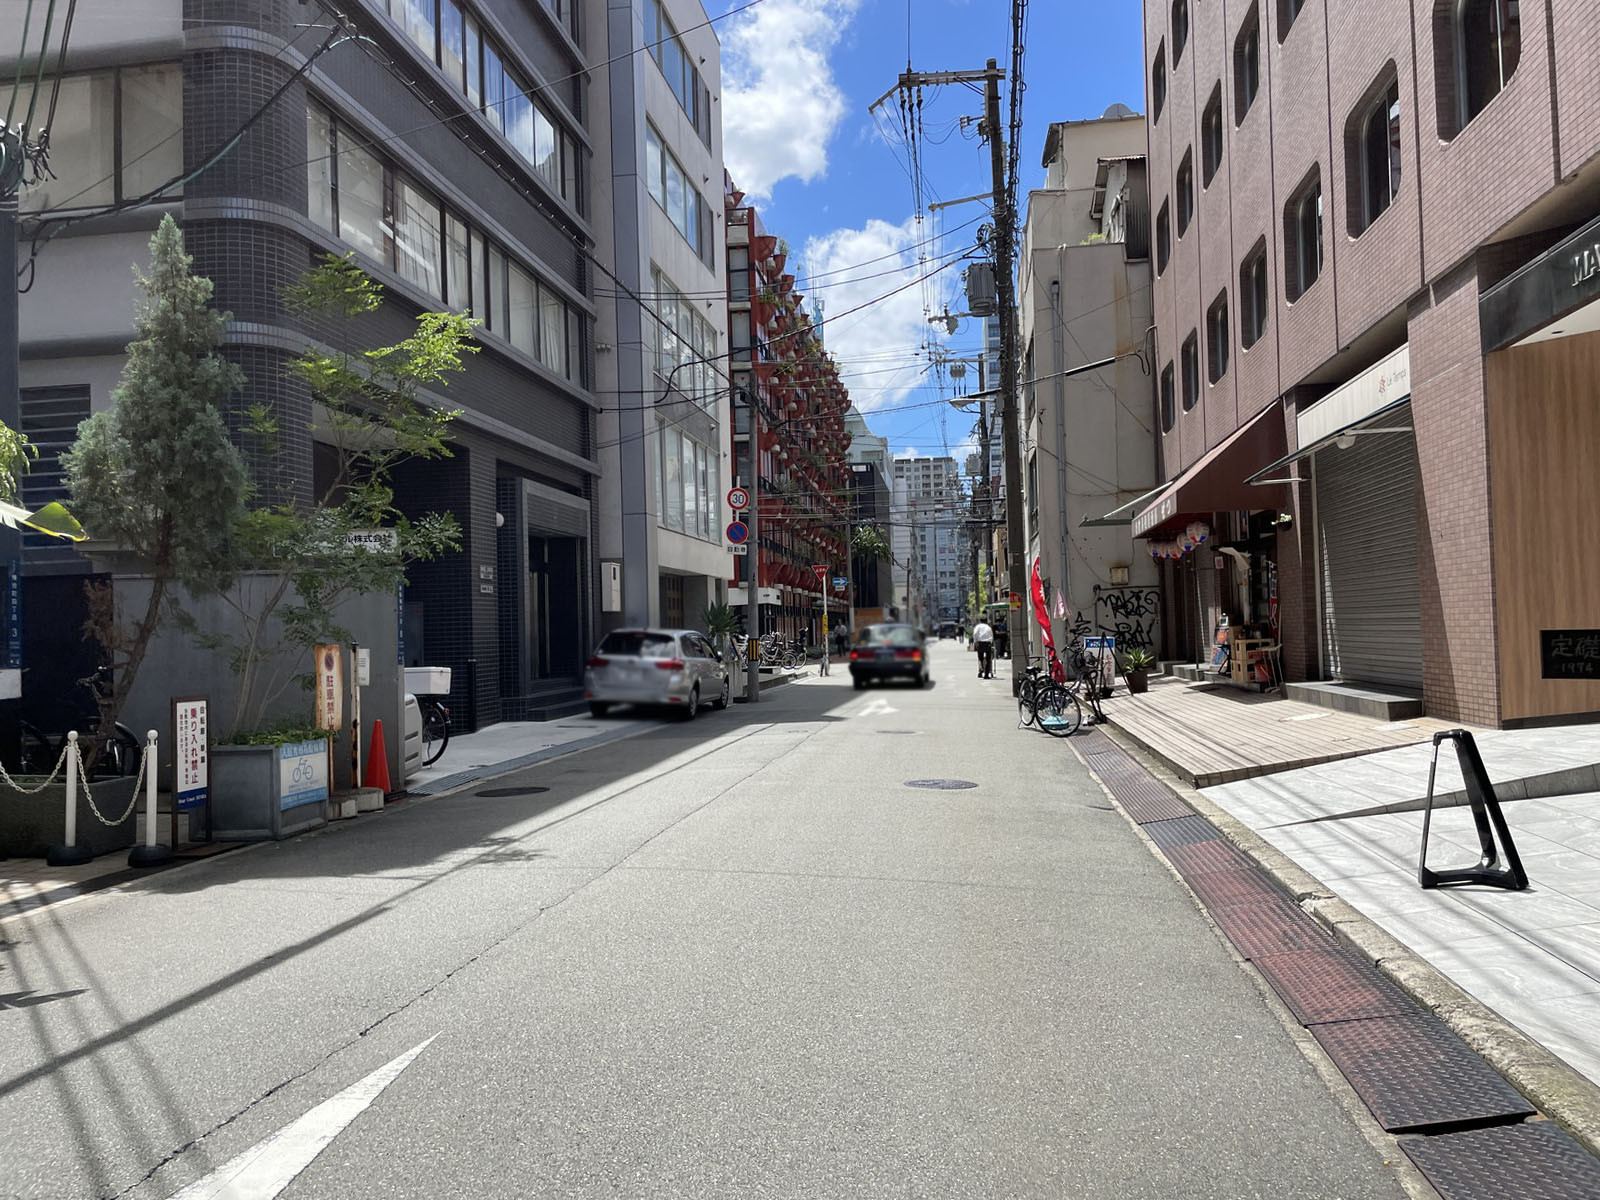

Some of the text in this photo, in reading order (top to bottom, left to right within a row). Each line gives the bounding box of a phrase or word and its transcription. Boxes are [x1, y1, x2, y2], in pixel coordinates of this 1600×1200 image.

[732, 493, 744, 504] 30
[12, 628, 17, 637] 3
[326, 675, 335, 728] 駐車禁止
[190, 708, 199, 784] 乗り入れ禁止
